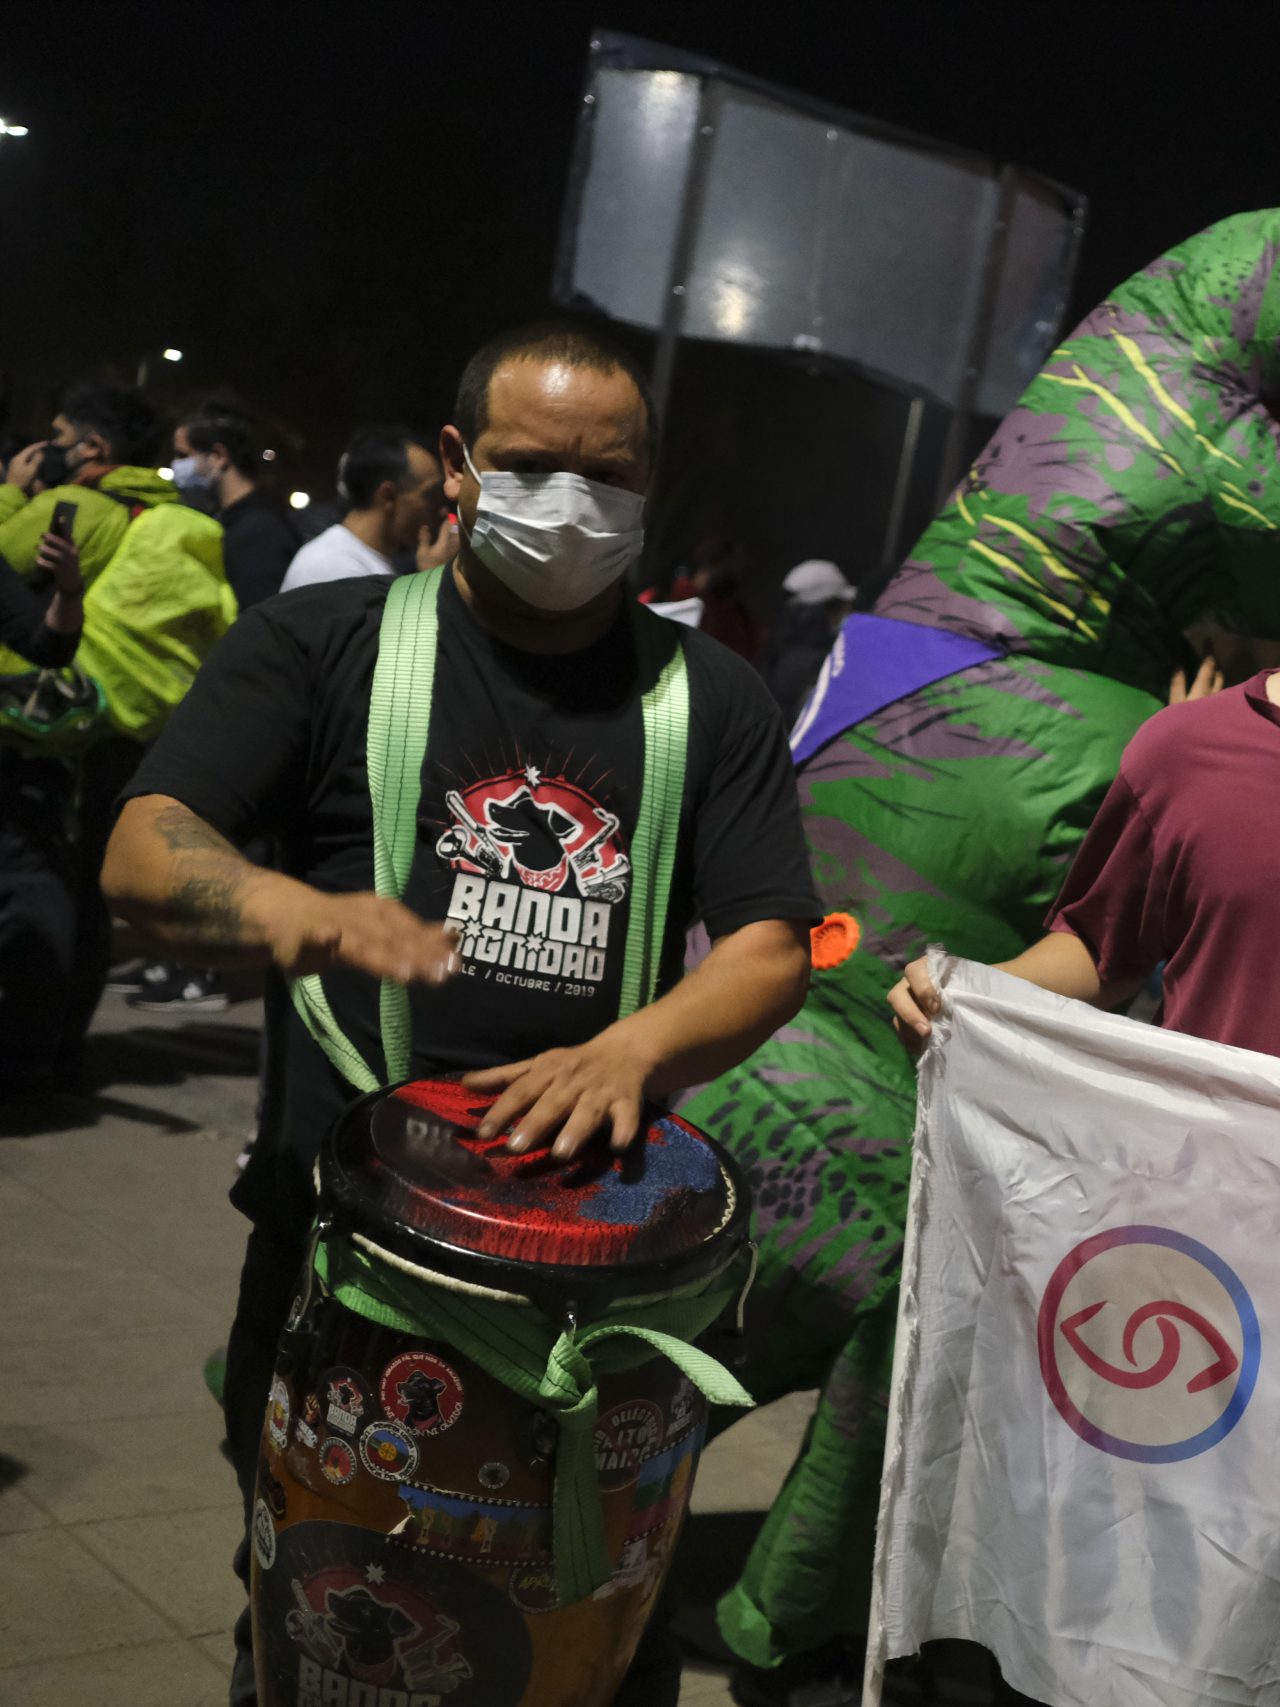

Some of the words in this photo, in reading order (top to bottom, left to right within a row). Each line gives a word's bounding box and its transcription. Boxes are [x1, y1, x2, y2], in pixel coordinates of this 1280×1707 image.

[447, 873, 612, 948] BANDA
[496, 973, 552, 992] OCTUBRE
[564, 983, 595, 997] 2019
